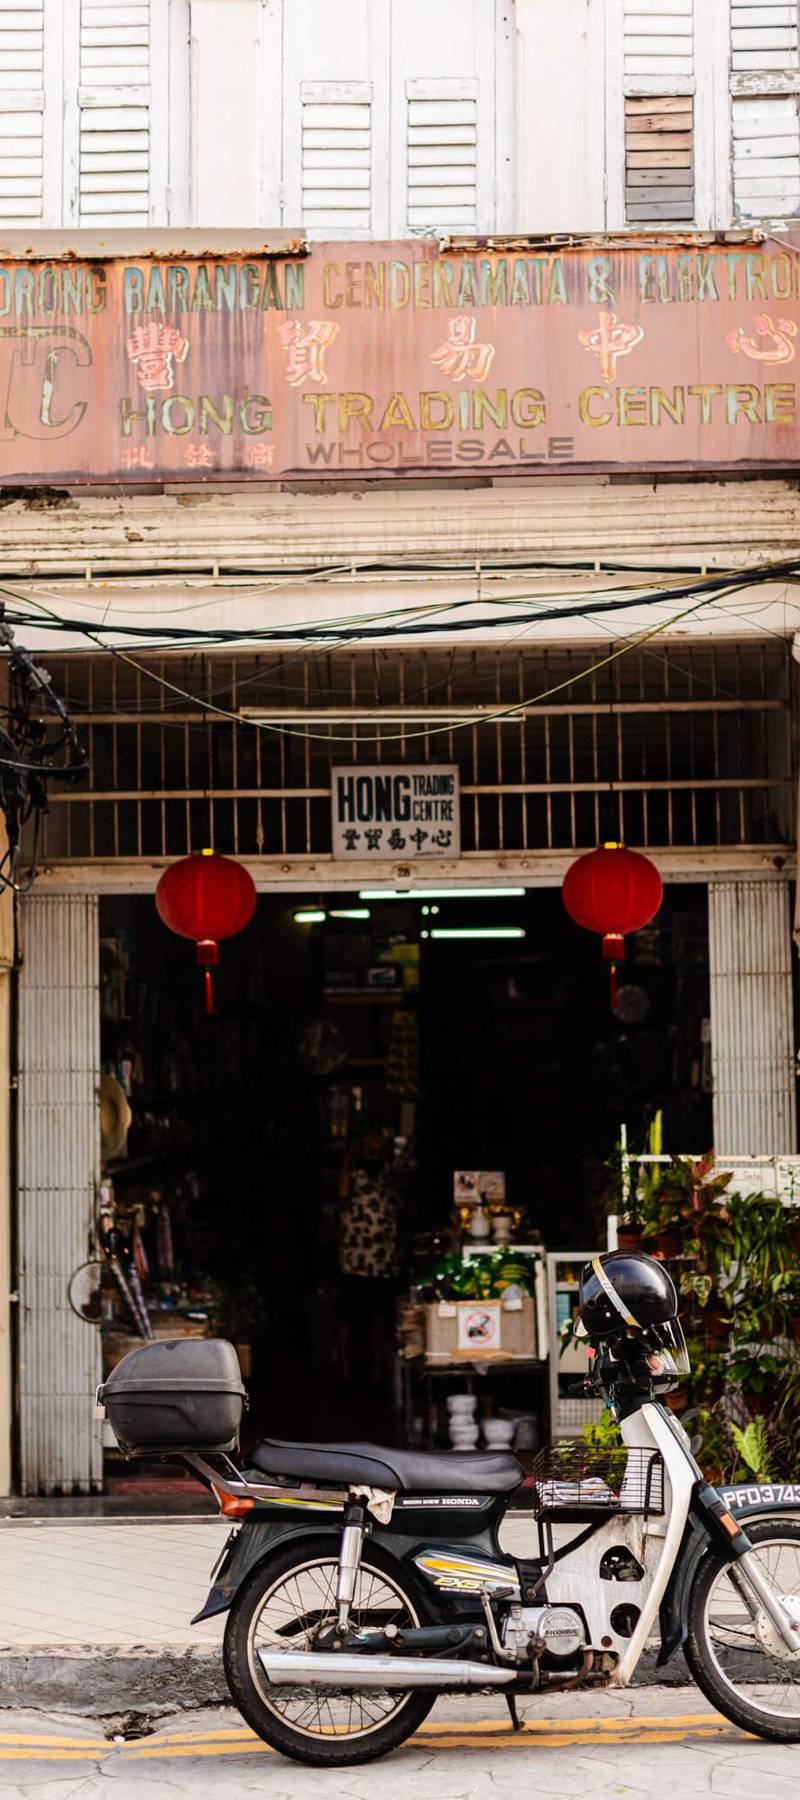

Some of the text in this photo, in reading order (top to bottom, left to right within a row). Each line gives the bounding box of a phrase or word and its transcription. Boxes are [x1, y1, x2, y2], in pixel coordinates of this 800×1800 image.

[124, 264, 306, 314] BARANGAN
[322, 256, 569, 310] CENDERAMATA
[588, 253, 616, 303] &
[639, 251, 800, 304] ELEKTRO
[120, 382, 796, 436] HONG TRADING CENTRE
[305, 436, 574, 465] WHOLESALE
[337, 775, 412, 823] HONG
[412, 774, 455, 796] TRADING
[412, 799, 454, 822] CENTRE
